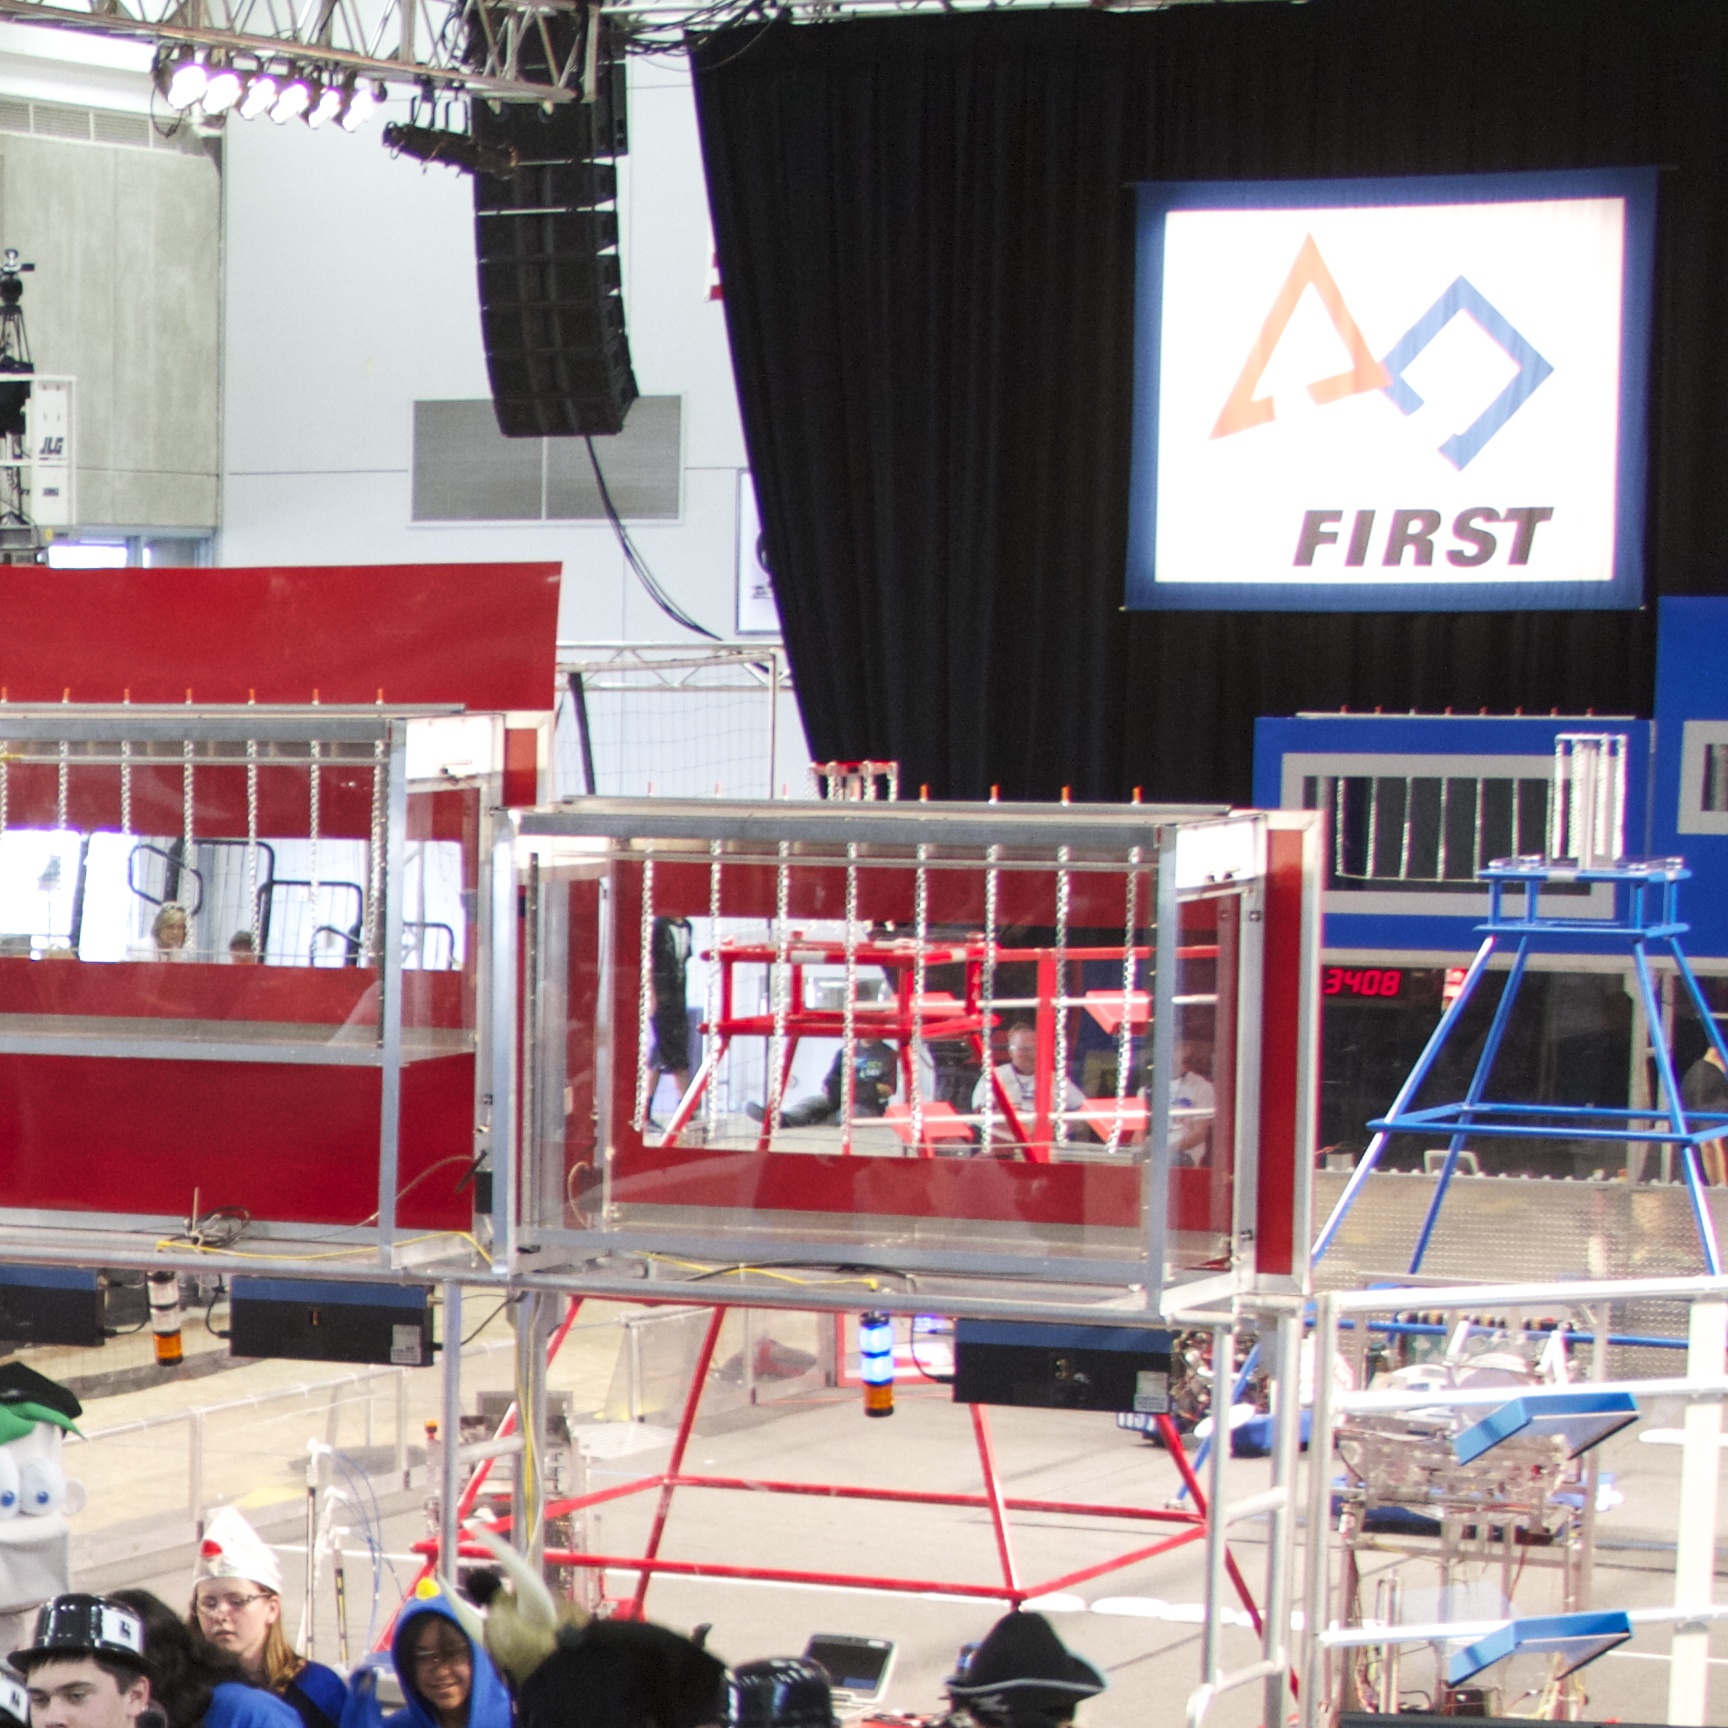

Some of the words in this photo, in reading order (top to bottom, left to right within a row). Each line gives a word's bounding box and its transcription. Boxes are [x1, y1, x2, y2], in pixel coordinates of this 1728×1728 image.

[39, 437, 63, 454] JLG
[1292, 506, 1555, 568] FIRST
[1324, 966, 1403, 998] 3408
